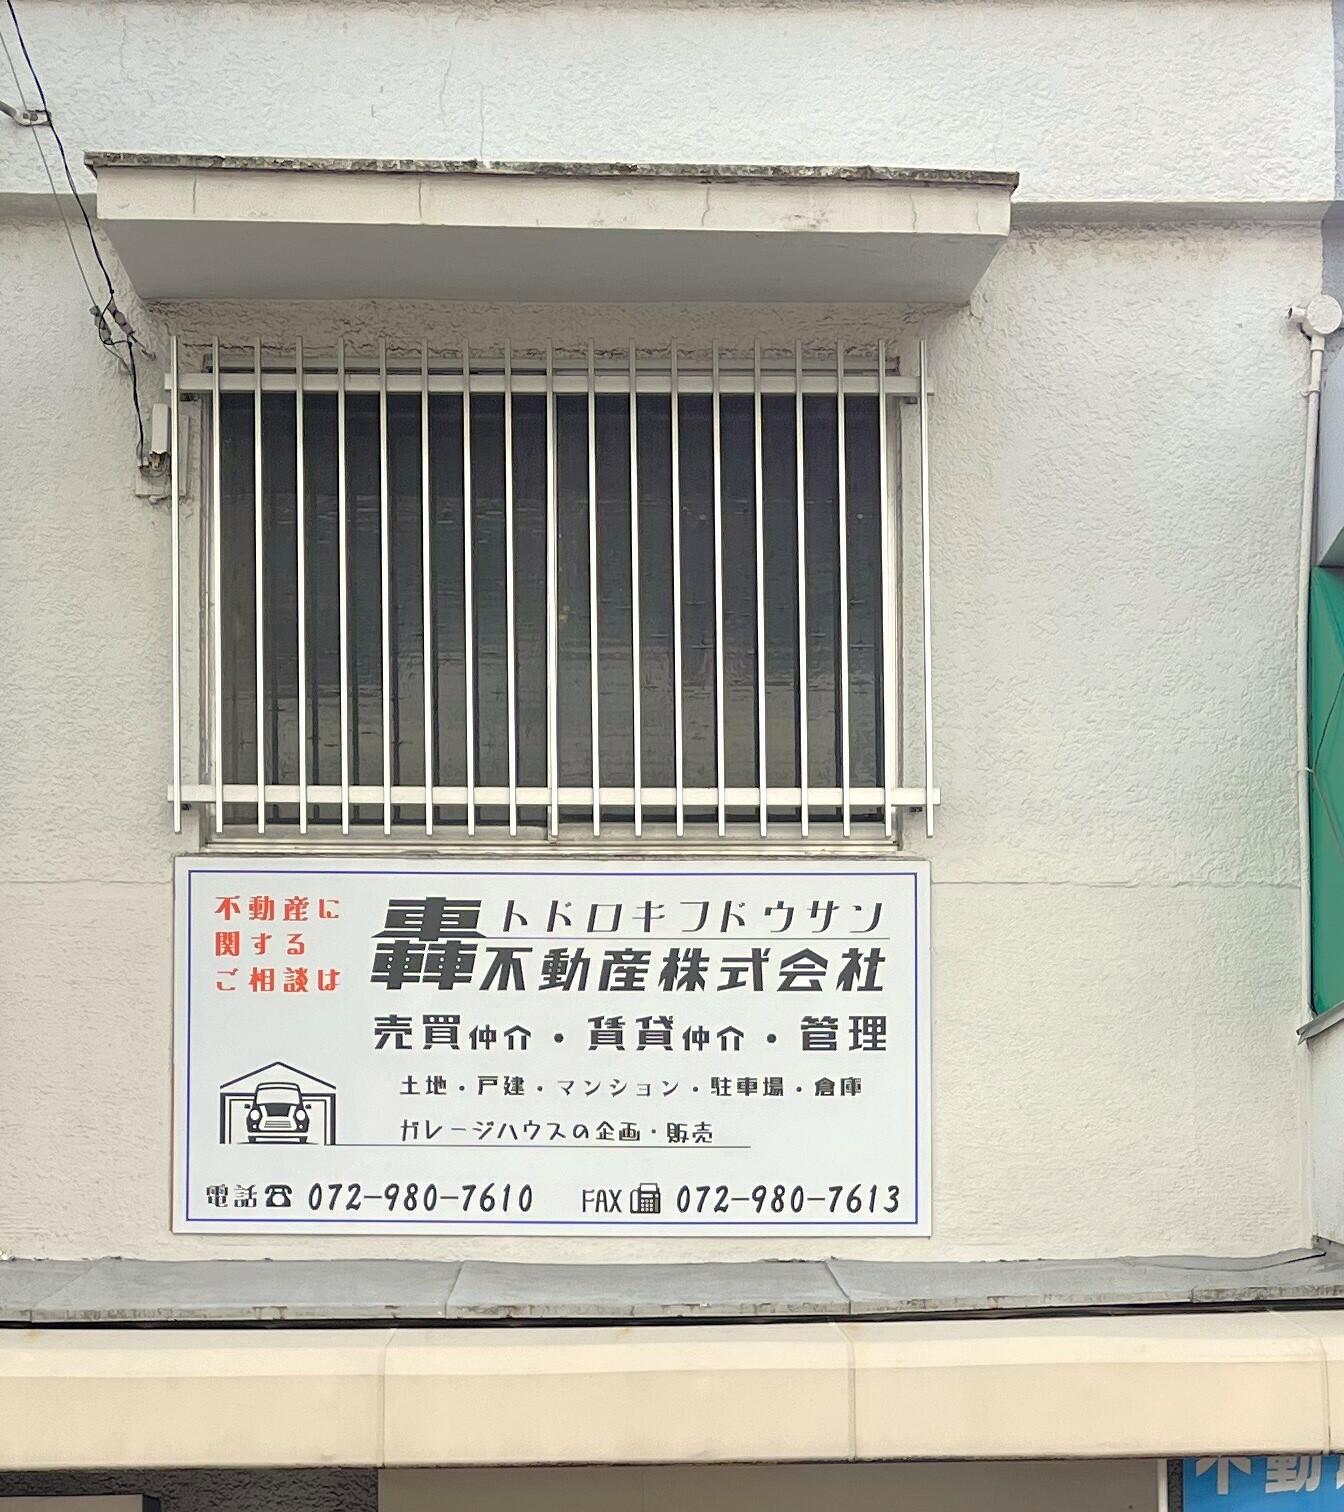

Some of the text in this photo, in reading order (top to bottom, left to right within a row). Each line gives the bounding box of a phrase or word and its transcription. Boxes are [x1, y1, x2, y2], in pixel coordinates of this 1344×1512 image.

[215, 896, 340, 921] 不動産に
[502, 899, 883, 934] トドロキフドウサン
[215, 931, 306, 957] 関する
[216, 967, 340, 993] ご相談は
[374, 1013, 887, 1052] 売買仲介・賃貸仲介・管理
[400, 1075, 862, 1098] 土地・戸建・マンション・駐車場・倉庫
[400, 1119, 713, 1144] ガレージハウスの企画・販売
[206, 1183, 533, 1213] 電話 072-980-7610
[582, 1183, 900, 1214] FAX 072-980-7613
